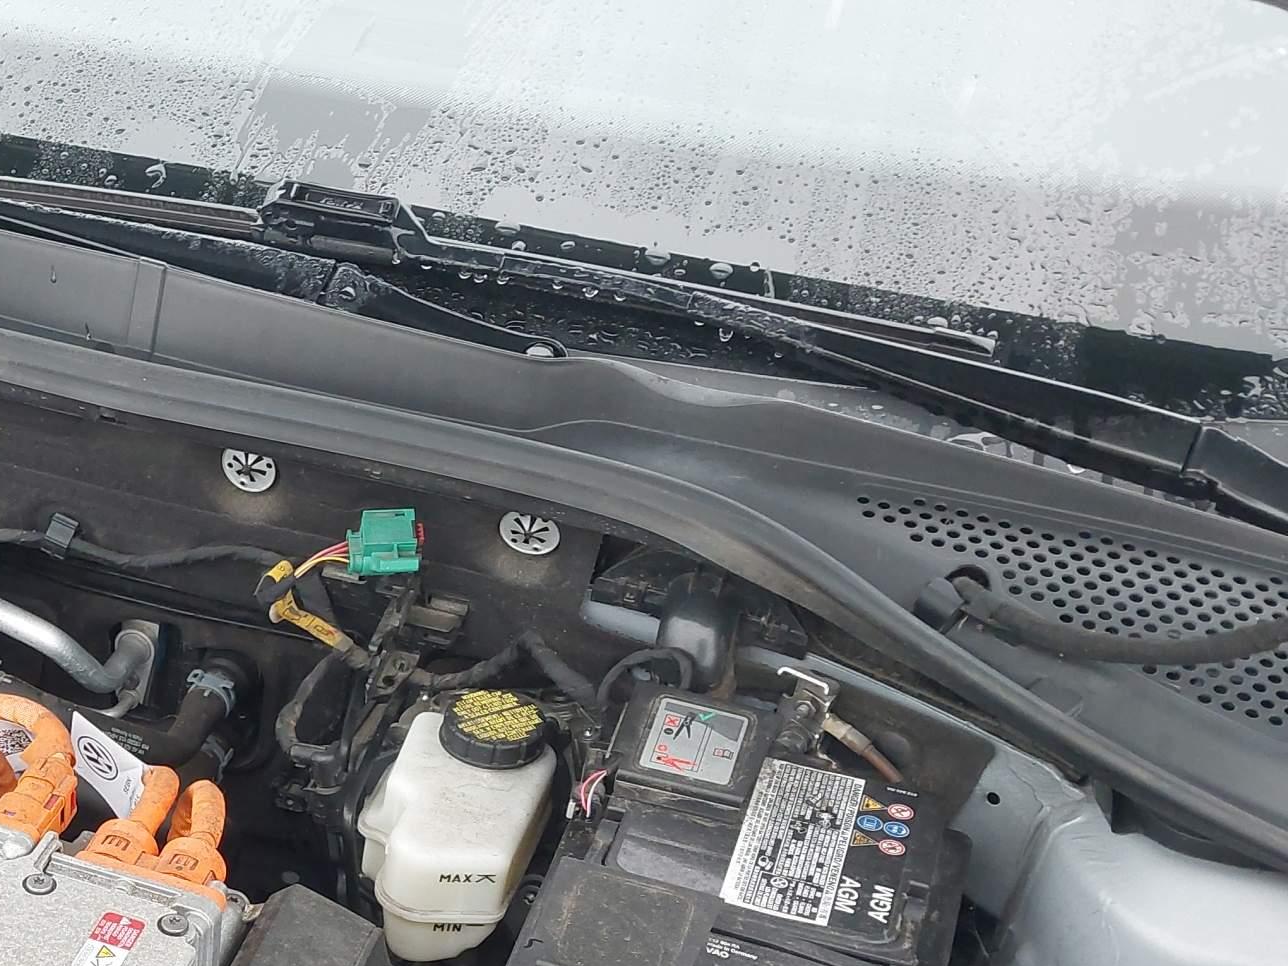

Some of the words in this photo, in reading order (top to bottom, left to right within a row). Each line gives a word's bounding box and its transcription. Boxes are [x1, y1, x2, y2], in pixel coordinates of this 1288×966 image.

[439, 873, 472, 883] MAX
[833, 875, 862, 914] AGM
[866, 884, 895, 923] AGM
[433, 923, 462, 932] MIN
